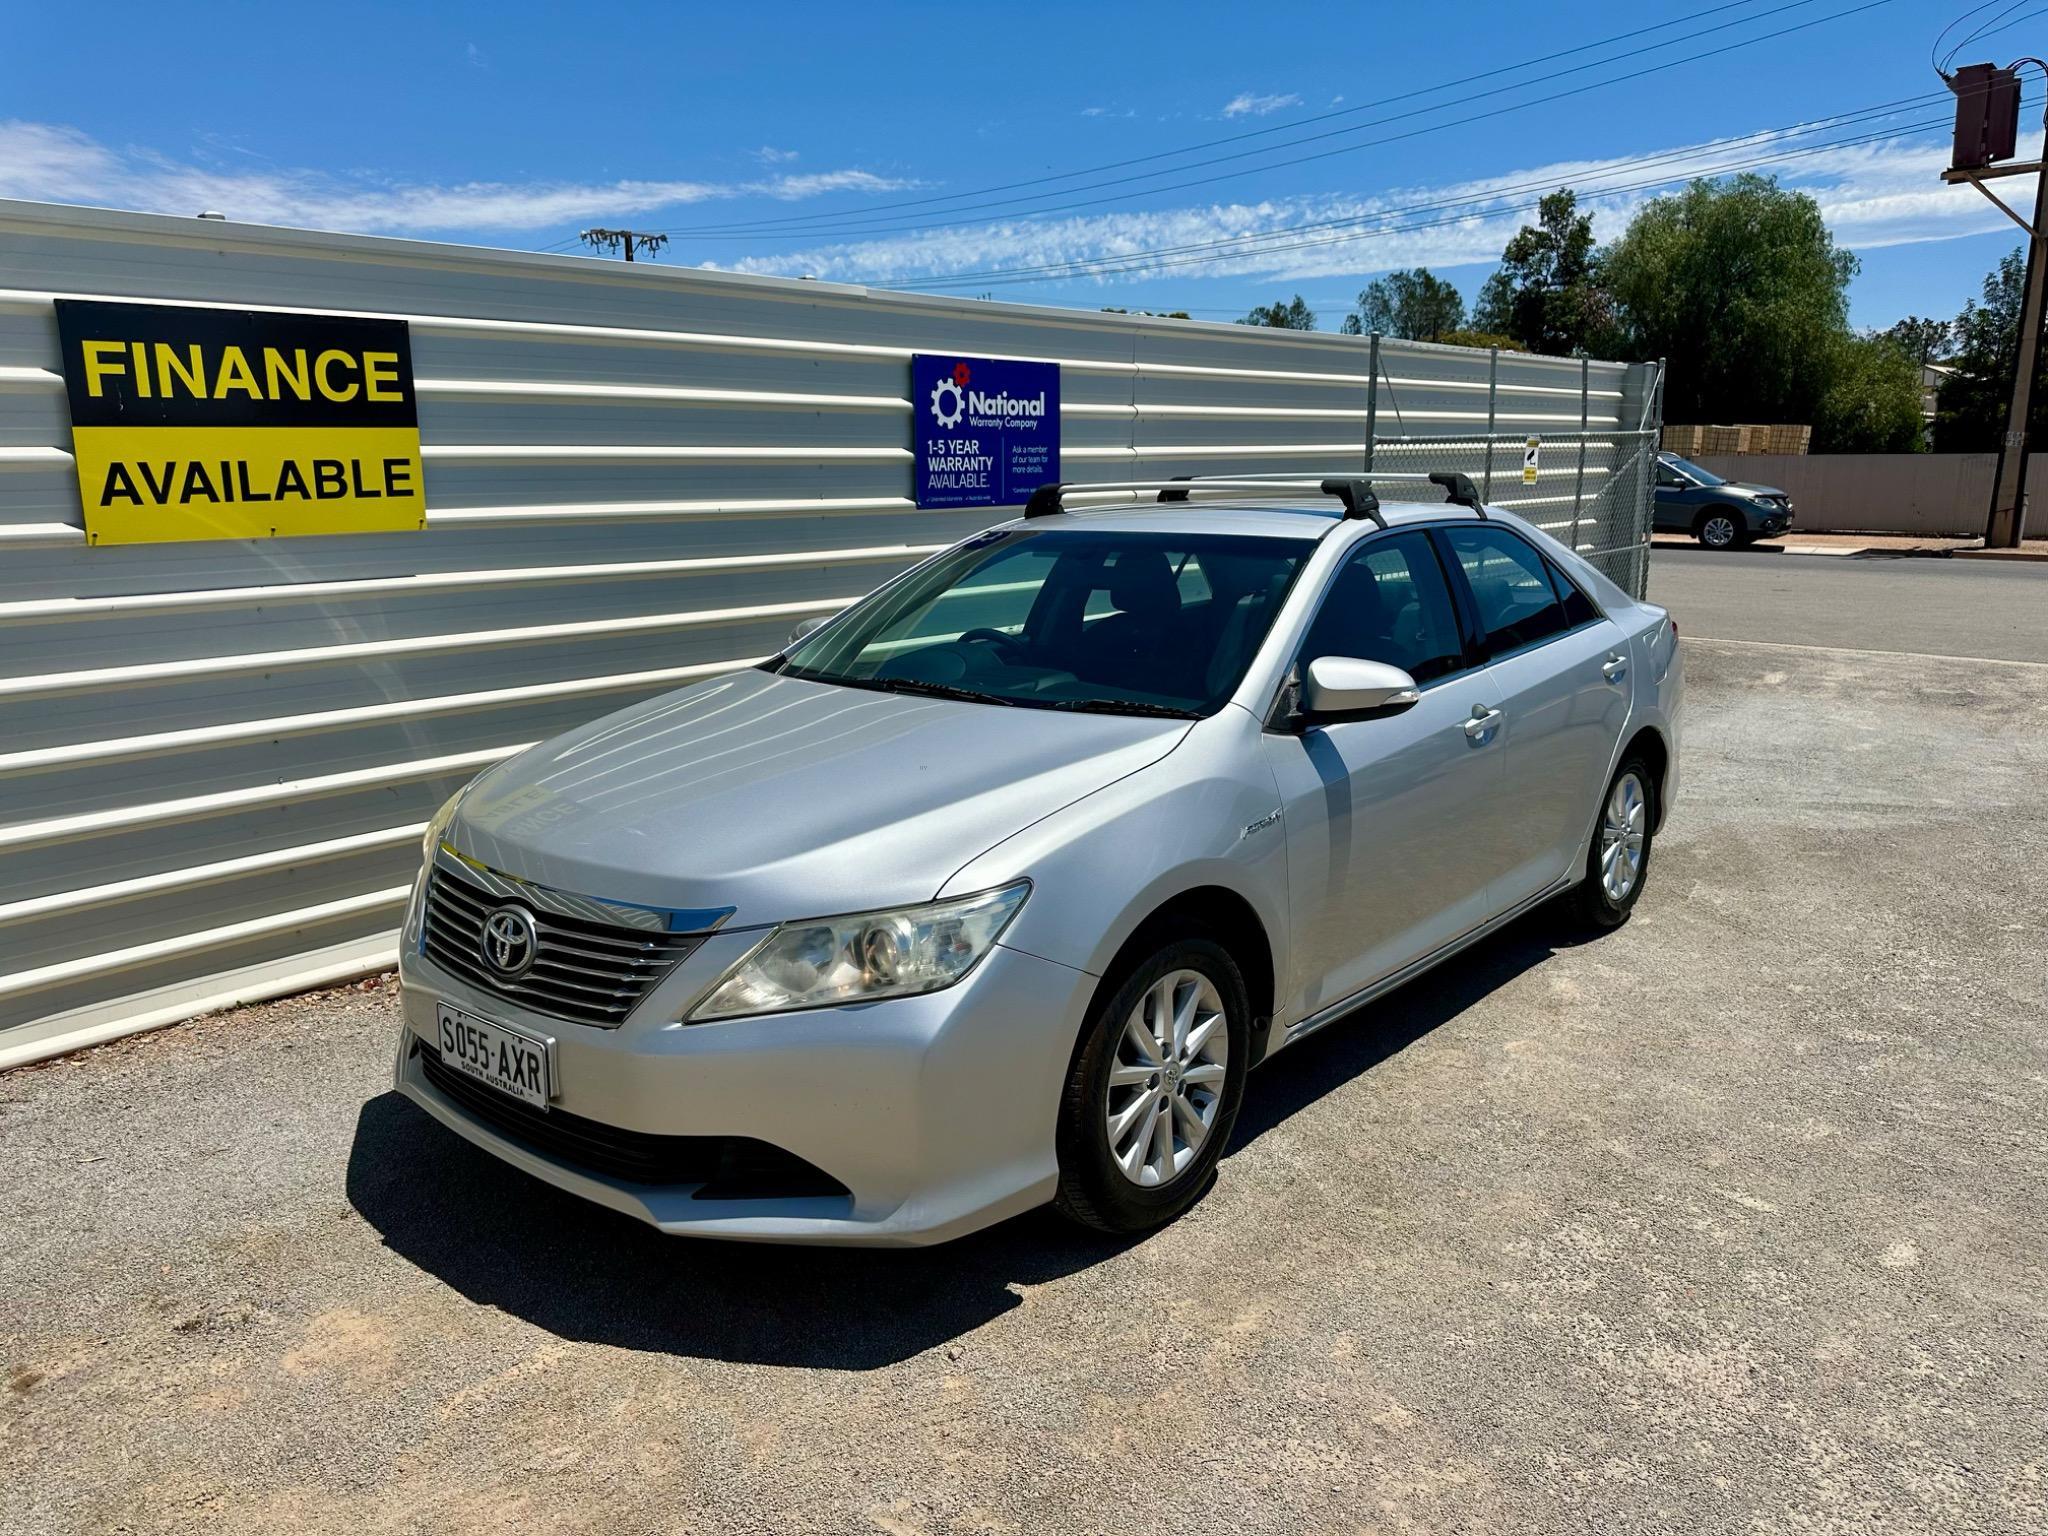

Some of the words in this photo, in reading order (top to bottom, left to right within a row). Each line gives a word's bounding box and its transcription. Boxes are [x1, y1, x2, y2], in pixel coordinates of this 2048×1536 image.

[82, 340, 403, 402] FINANCE
[968, 391, 1045, 417] National
[968, 415, 1003, 430] Warranty
[1004, 416, 1038, 430] Company
[927, 439, 946, 455] 1-5
[948, 439, 980, 455] YEAR
[927, 456, 994, 472] WARRANTY
[99, 458, 415, 507] AVAILABLE
[927, 473, 991, 489] AVAILABLE.
[460, 1061, 484, 1079] SOUTH
[485, 1074, 525, 1098] AUSTRALIA
